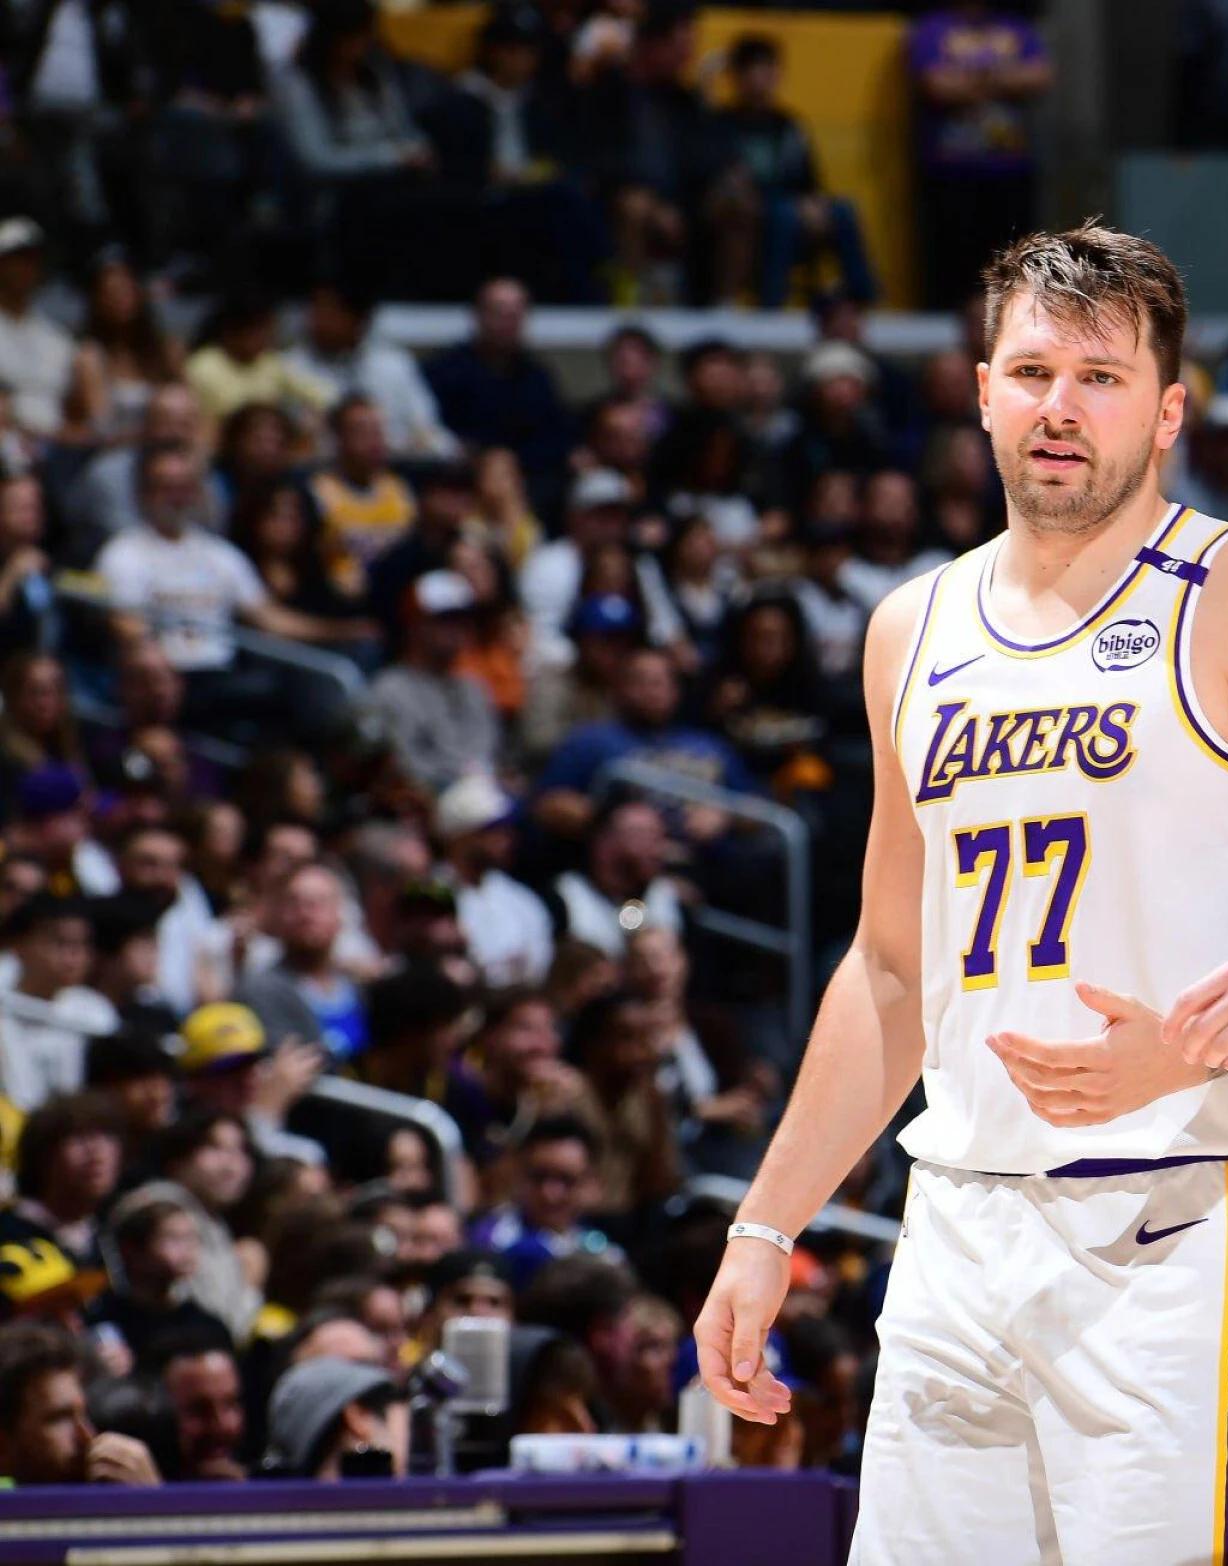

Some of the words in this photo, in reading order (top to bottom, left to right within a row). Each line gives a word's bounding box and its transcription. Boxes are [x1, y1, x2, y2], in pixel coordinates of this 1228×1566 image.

[1098, 632, 1156, 655] bibigo
[914, 698, 1140, 807] LAKERS
[951, 811, 1092, 992] 77
